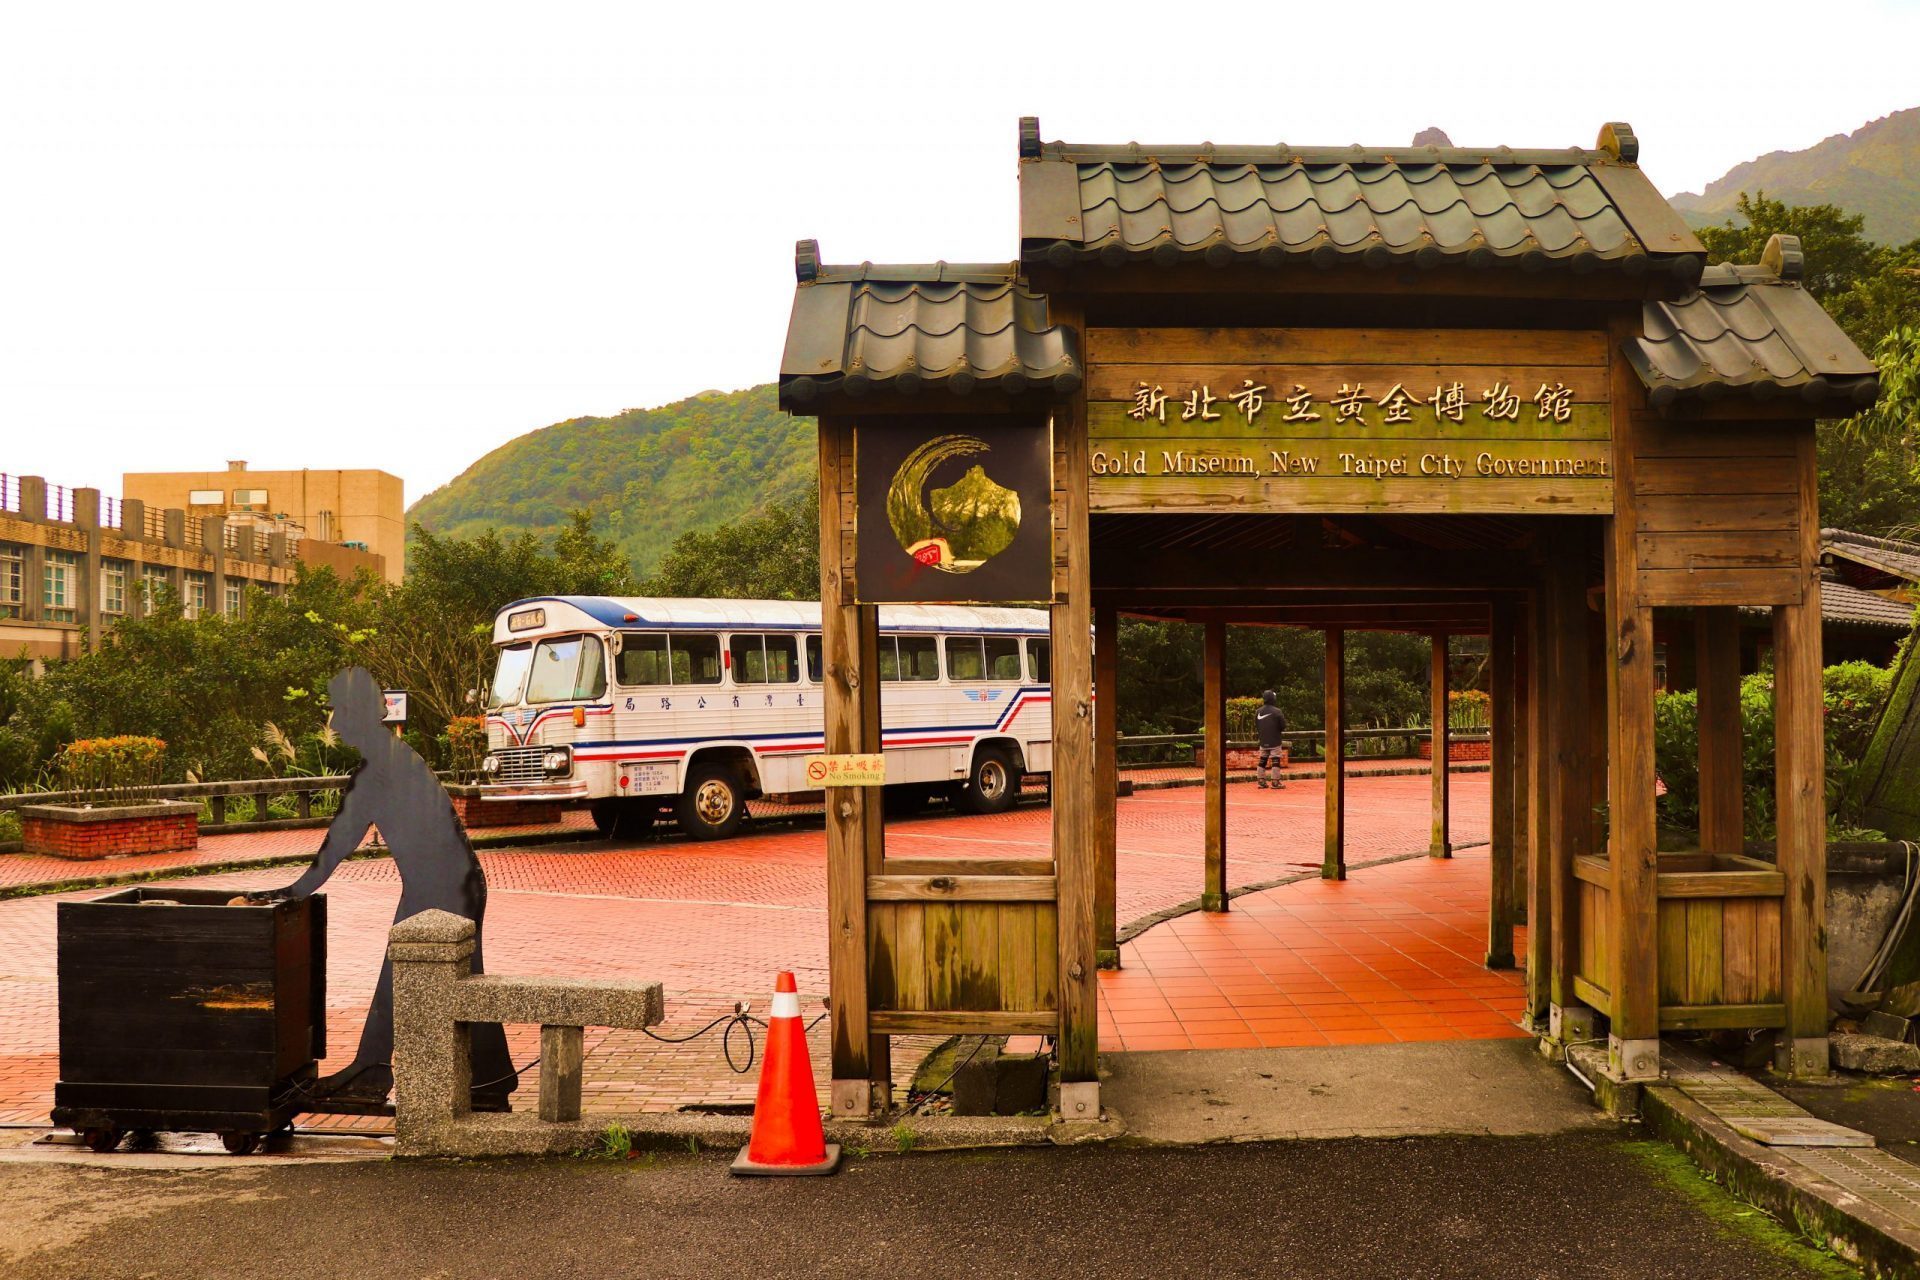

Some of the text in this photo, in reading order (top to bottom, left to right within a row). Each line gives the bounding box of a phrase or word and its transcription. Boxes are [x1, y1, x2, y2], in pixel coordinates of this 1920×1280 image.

[1127, 379, 1574, 425] 新北市立黃金博物館
[1091, 451, 1608, 479] Gold Museum, New Taipei City Government
[843, 772, 880, 780] Smoking
